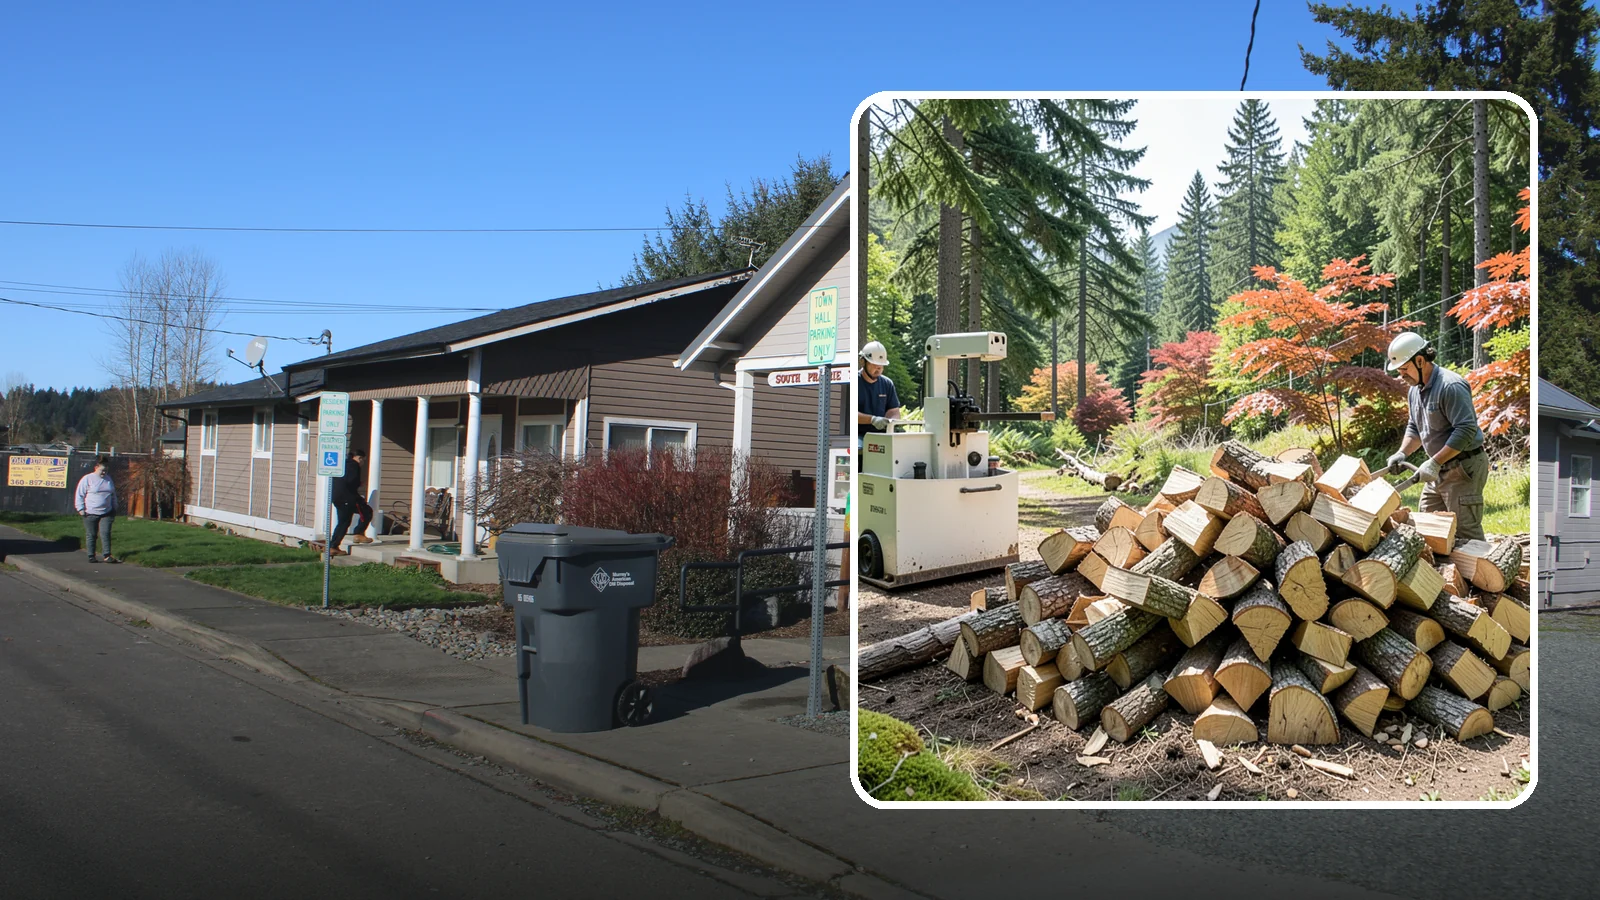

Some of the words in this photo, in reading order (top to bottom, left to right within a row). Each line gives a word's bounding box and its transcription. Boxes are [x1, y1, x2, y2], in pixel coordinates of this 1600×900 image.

[815, 294, 833, 308] TOWN
[814, 311, 831, 325] HALL
[809, 326, 836, 340] PARKING
[813, 344, 831, 357] ONLY
[775, 373, 801, 384] SOUTH
[807, 370, 842, 383] PRIE
